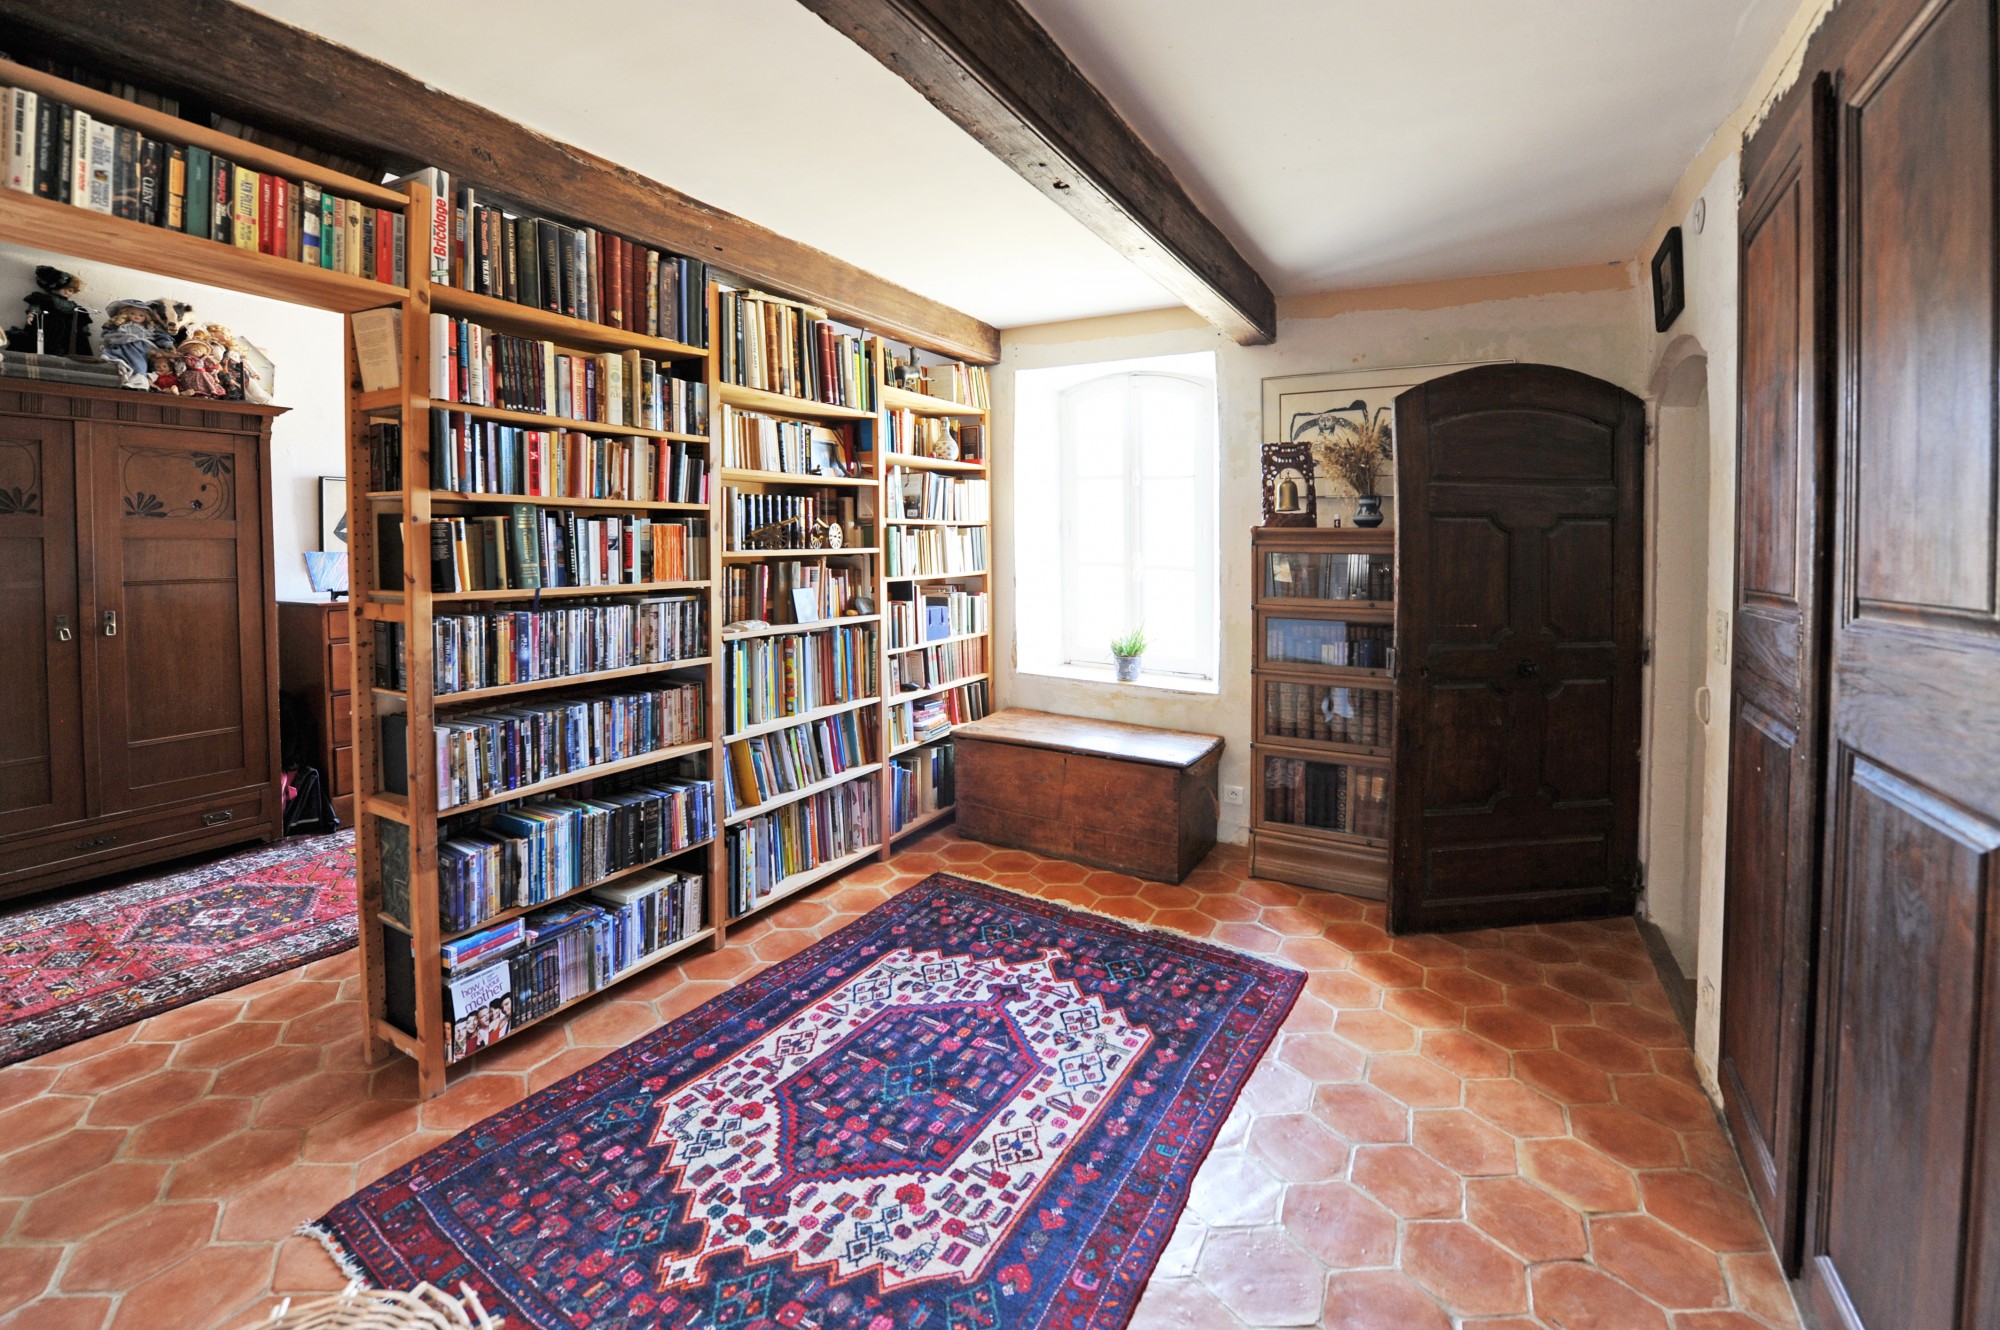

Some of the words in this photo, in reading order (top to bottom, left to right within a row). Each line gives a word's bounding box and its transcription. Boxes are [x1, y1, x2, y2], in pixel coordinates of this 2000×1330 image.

[142, 175, 155, 205] CLIENT
[433, 197, 447, 257] Bricolage
[481, 258, 490, 285] TOLKIEN
[461, 981, 480, 999] how
[464, 981, 504, 1014] mother
[470, 985, 484, 1000] met
[486, 977, 501, 991] your
